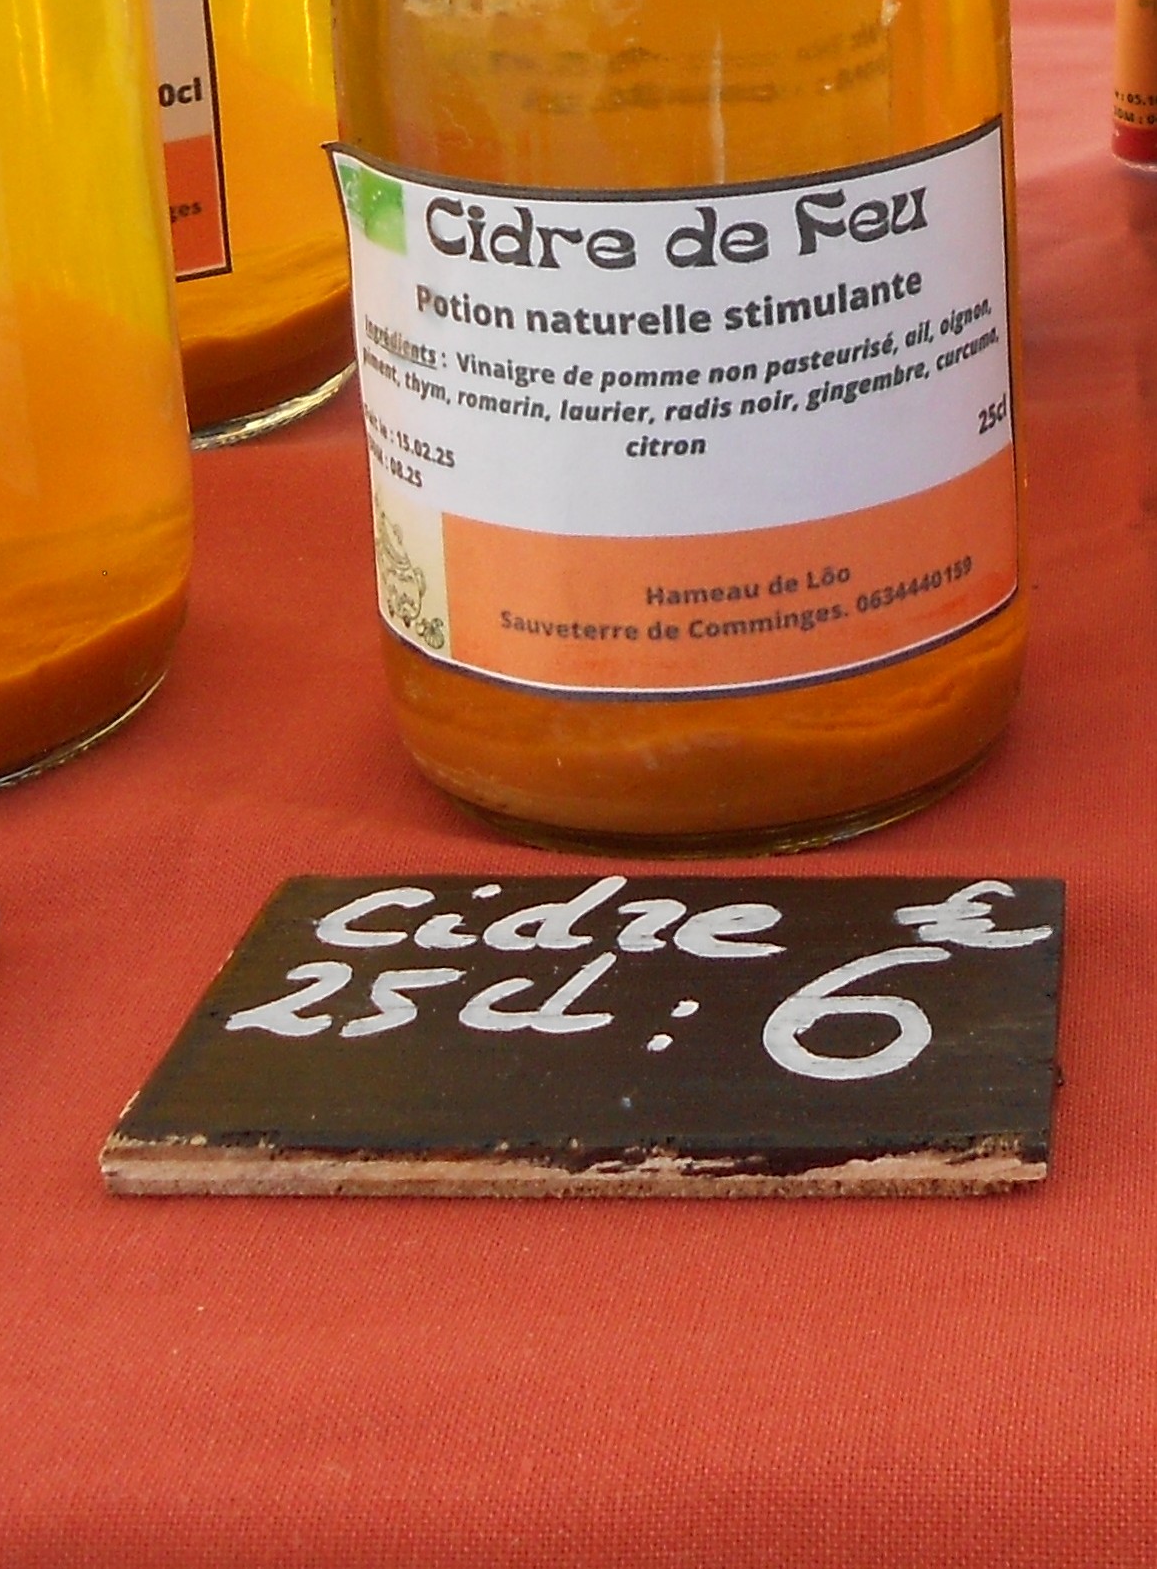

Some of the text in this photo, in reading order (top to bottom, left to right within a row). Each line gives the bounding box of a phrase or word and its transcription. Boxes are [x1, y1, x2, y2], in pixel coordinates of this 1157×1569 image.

[158, 76, 202, 107] 0cl
[424, 186, 929, 270] Cidre de Feu
[416, 268, 922, 336] Potion naturelle stimulante
[405, 372, 451, 405] thym,
[457, 388, 551, 423] romarin,
[559, 400, 655, 425] laurier,
[665, 396, 732, 422] radis
[739, 386, 799, 417] noir,
[806, 363, 930, 412] gingembre,
[936, 328, 999, 371] curcuma,
[456, 351, 555, 388] Vinaigre
[563, 363, 593, 388] de
[600, 365, 700, 392] pomme
[708, 362, 757, 384] non
[766, 331, 899, 380] pasteurisé,
[905, 319, 934, 347] ail,
[940, 298, 992, 335] oignon,
[625, 436, 706, 459] citron
[978, 393, 1007, 435] 25cl
[390, 456, 423, 488] 08.25
[396, 431, 455, 468] 15.02.25
[500, 555, 973, 642] Sauveterre de Comminges. 0634440159
[646, 583, 760, 608] Hameau
[769, 576, 799, 595] de
[315, 875, 1053, 960] Cidre €
[762, 946, 952, 1080] 6
